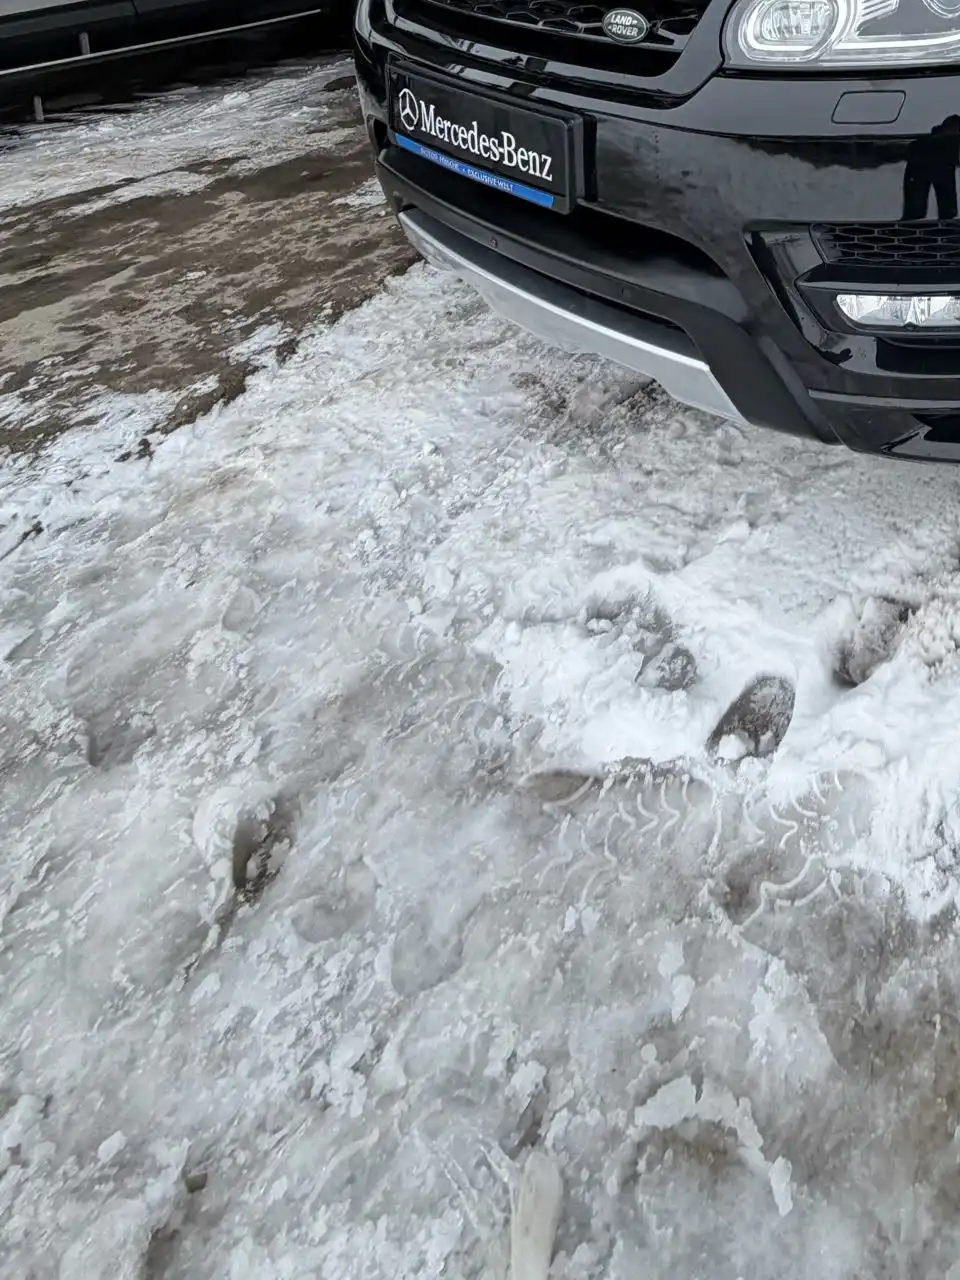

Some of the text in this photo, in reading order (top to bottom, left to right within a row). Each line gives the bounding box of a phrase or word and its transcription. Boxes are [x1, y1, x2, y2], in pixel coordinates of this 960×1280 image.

[610, 14, 633, 26] LAND
[611, 24, 639, 37] ROVER
[419, 99, 554, 182] Mercedes-Benz
